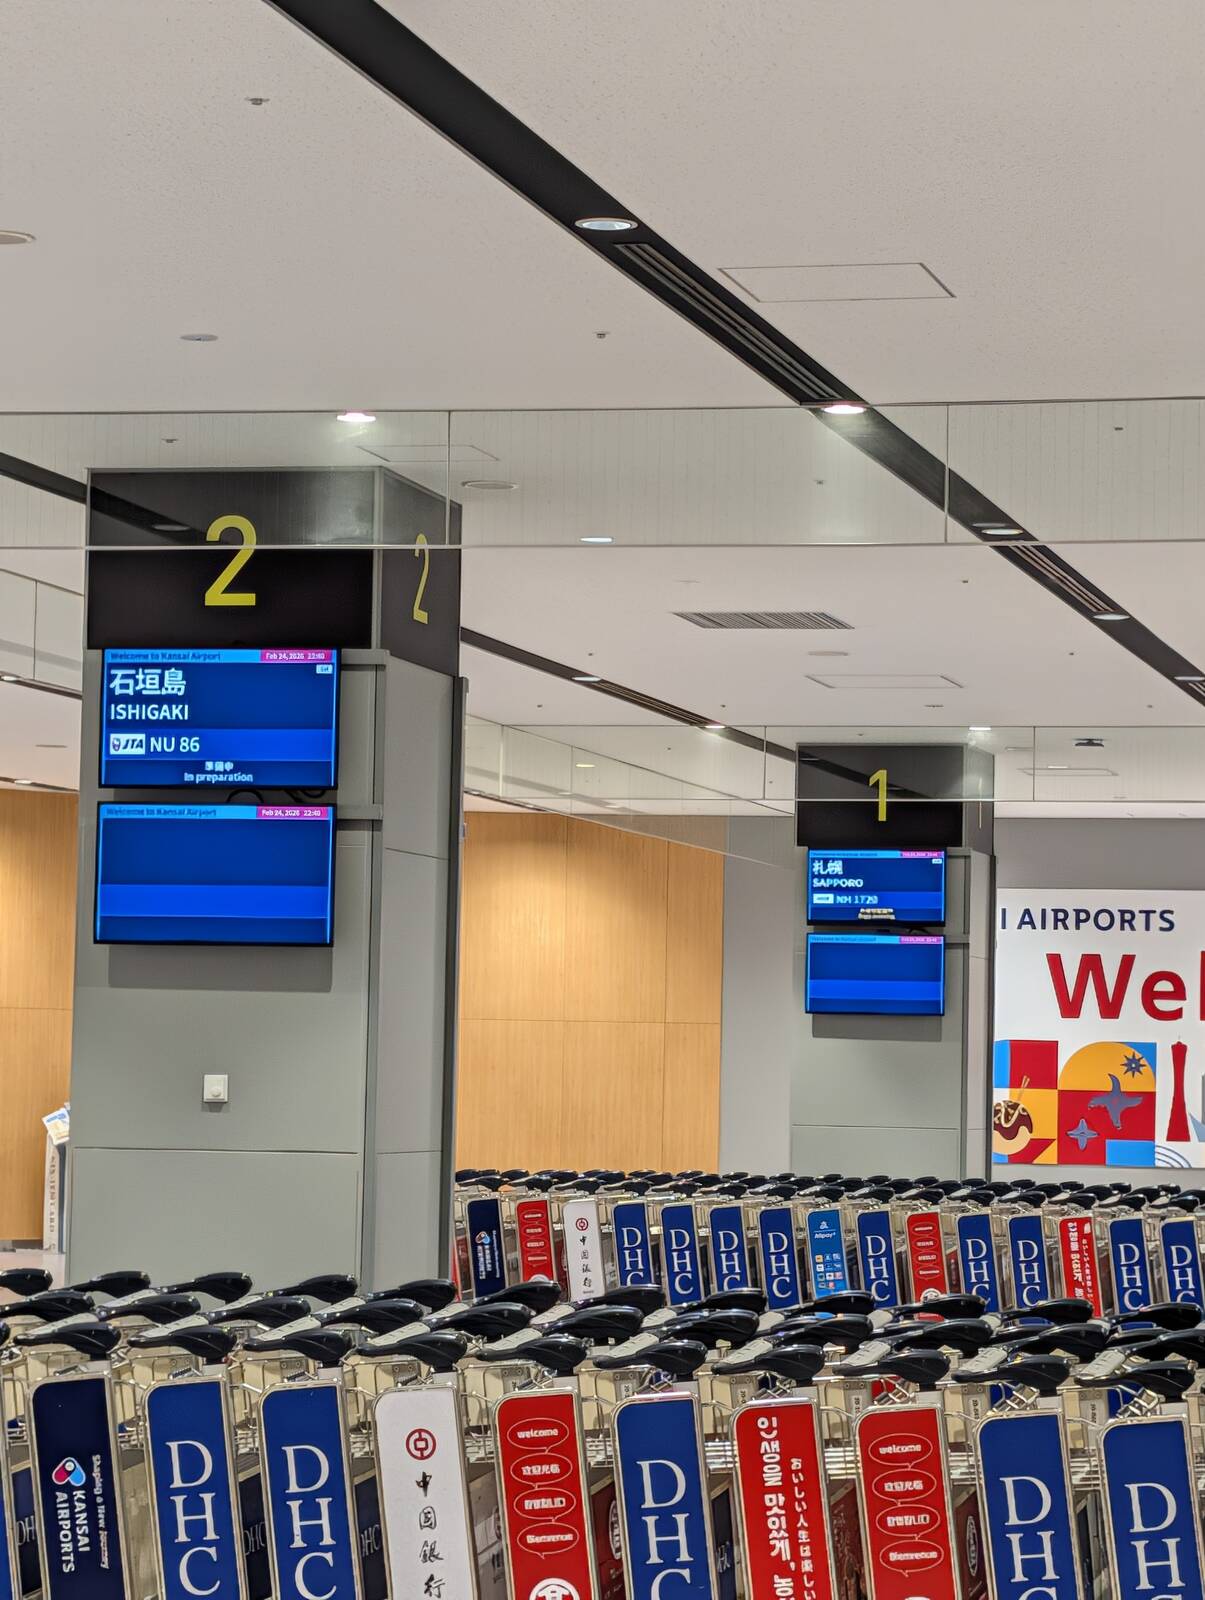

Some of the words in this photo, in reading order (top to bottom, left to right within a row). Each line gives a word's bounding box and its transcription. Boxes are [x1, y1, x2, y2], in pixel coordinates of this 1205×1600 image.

[204, 514, 257, 607] 2
[412, 533, 429, 625] 2
[109, 667, 187, 696] 石垣島
[110, 703, 189, 720] ISHIGAKI
[150, 736, 175, 752] NU
[179, 736, 200, 752] 86
[184, 772, 194, 782] In
[196, 771, 253, 784] preparation
[868, 768, 888, 822] 1
[812, 878, 864, 888] SAPPORO
[1016, 908, 1175, 932] AIRPORTS
[669, 1229, 694, 1295] DHC
[767, 1232, 792, 1298] DHC
[865, 1235, 891, 1301] DHC
[1017, 1240, 1041, 1307] DHC
[1118, 1243, 1144, 1310] DHC
[517, 1428, 559, 1439] welcome
[757, 1416, 783, 1487] 인생을
[879, 1444, 922, 1455] welcome
[55, 1491, 75, 1573] AIRPORTS
[73, 1490, 90, 1551] KANSAI
[165, 1440, 221, 1597] DHC
[281, 1445, 337, 1600] DHC
[764, 1493, 796, 1572] 맛있게,
[1000, 1476, 1060, 1600] DH
[1124, 1482, 1186, 1600] DH
